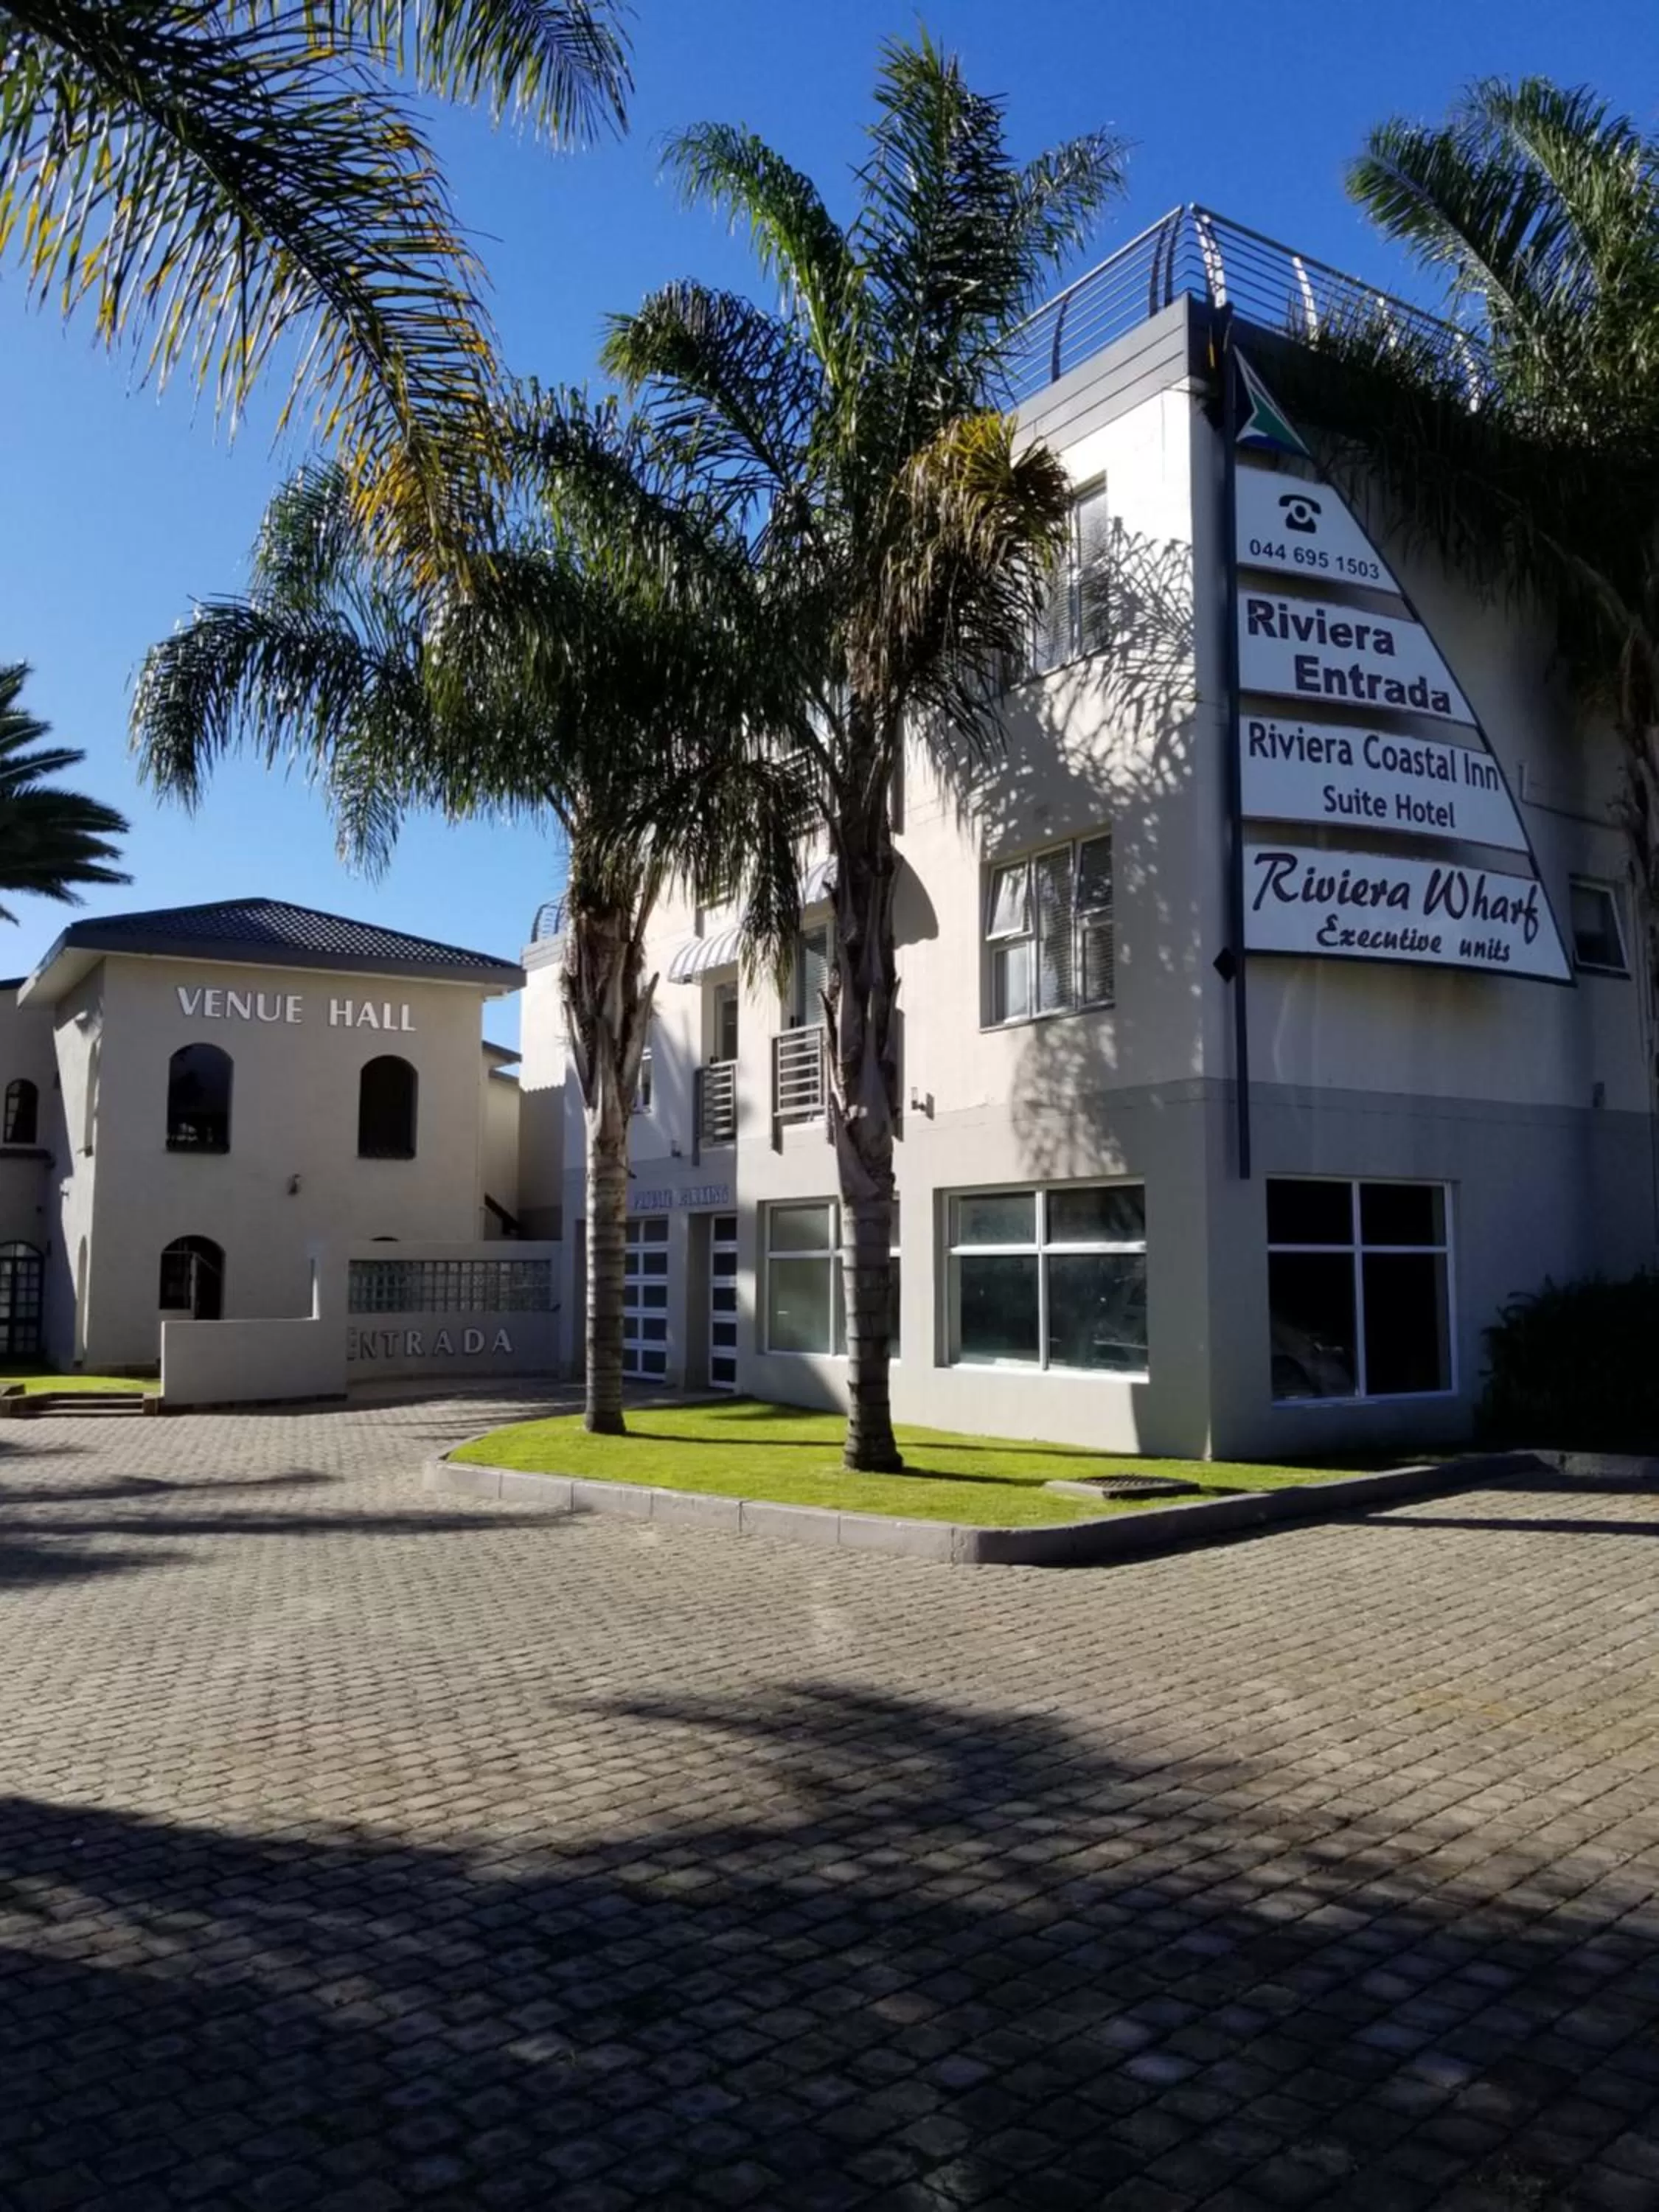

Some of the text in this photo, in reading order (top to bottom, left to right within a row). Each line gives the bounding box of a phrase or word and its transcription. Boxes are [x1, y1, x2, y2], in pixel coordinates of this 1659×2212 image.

[1249, 539, 1380, 580] 044 695 1503
[1247, 598, 1396, 656] Riviera
[1294, 654, 1452, 714] Entrada
[1248, 721, 1499, 791] Riviera Coastal Inn
[1322, 785, 1456, 829] Suite Hotel
[1252, 852, 1539, 945] Riviera Wharf
[1316, 914, 1511, 963] Executive units
[176, 987, 417, 1032] VENUE HALL
